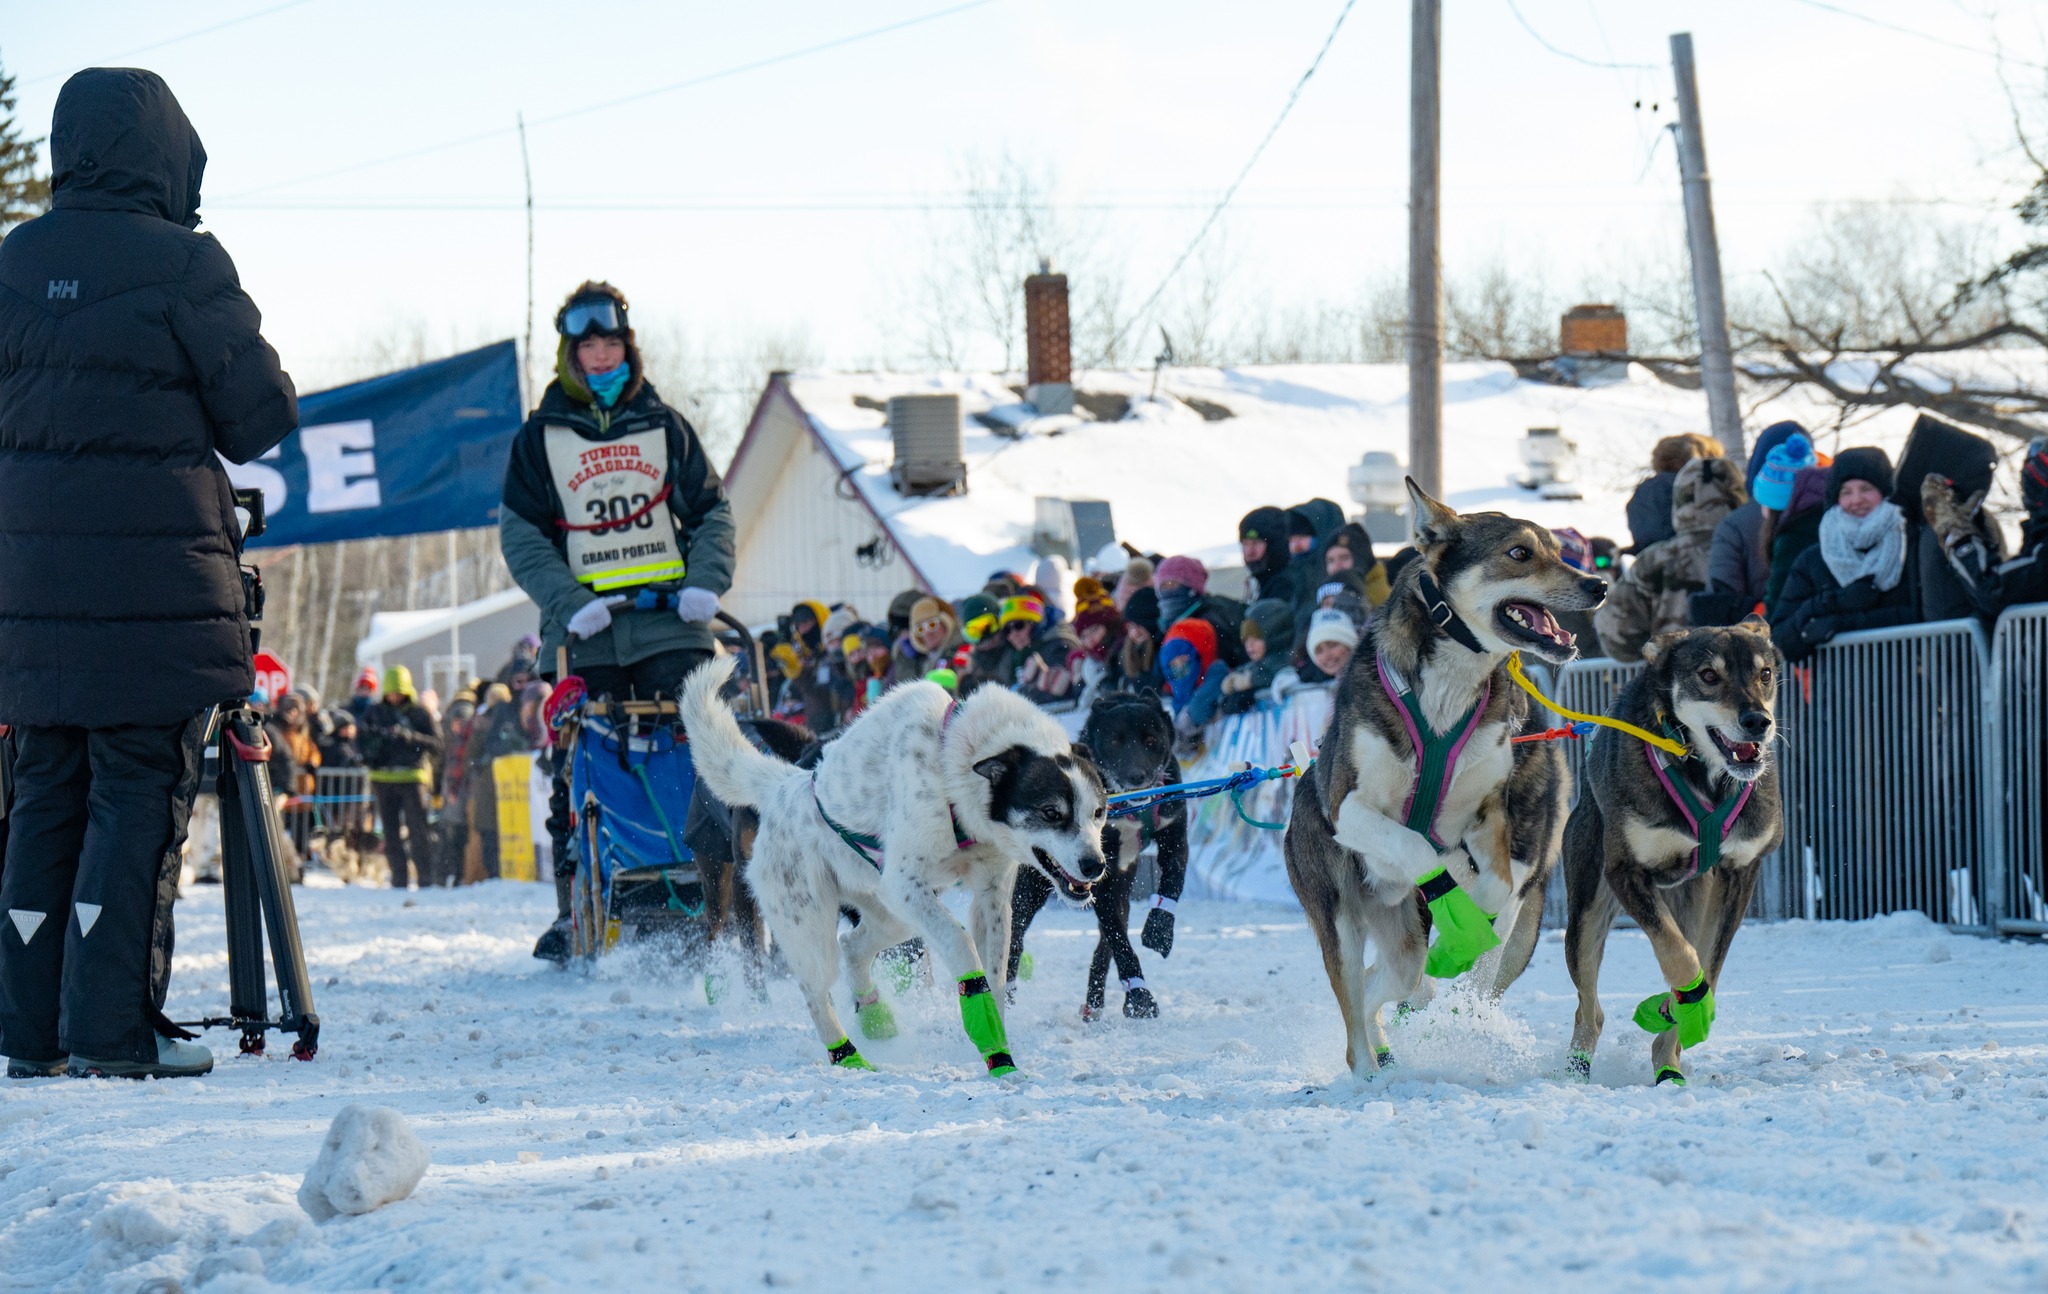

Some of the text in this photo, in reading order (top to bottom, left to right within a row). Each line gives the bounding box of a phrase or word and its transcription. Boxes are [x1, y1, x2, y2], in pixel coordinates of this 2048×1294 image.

[47, 280, 78, 299] HH
[580, 445, 640, 465] JUNIOR
[567, 459, 660, 493] BEARGREASE
[586, 493, 654, 536] 303
[582, 549, 619, 566] GRAND
[254, 669, 287, 701] OP
[256, 764, 270, 806] sachtler
